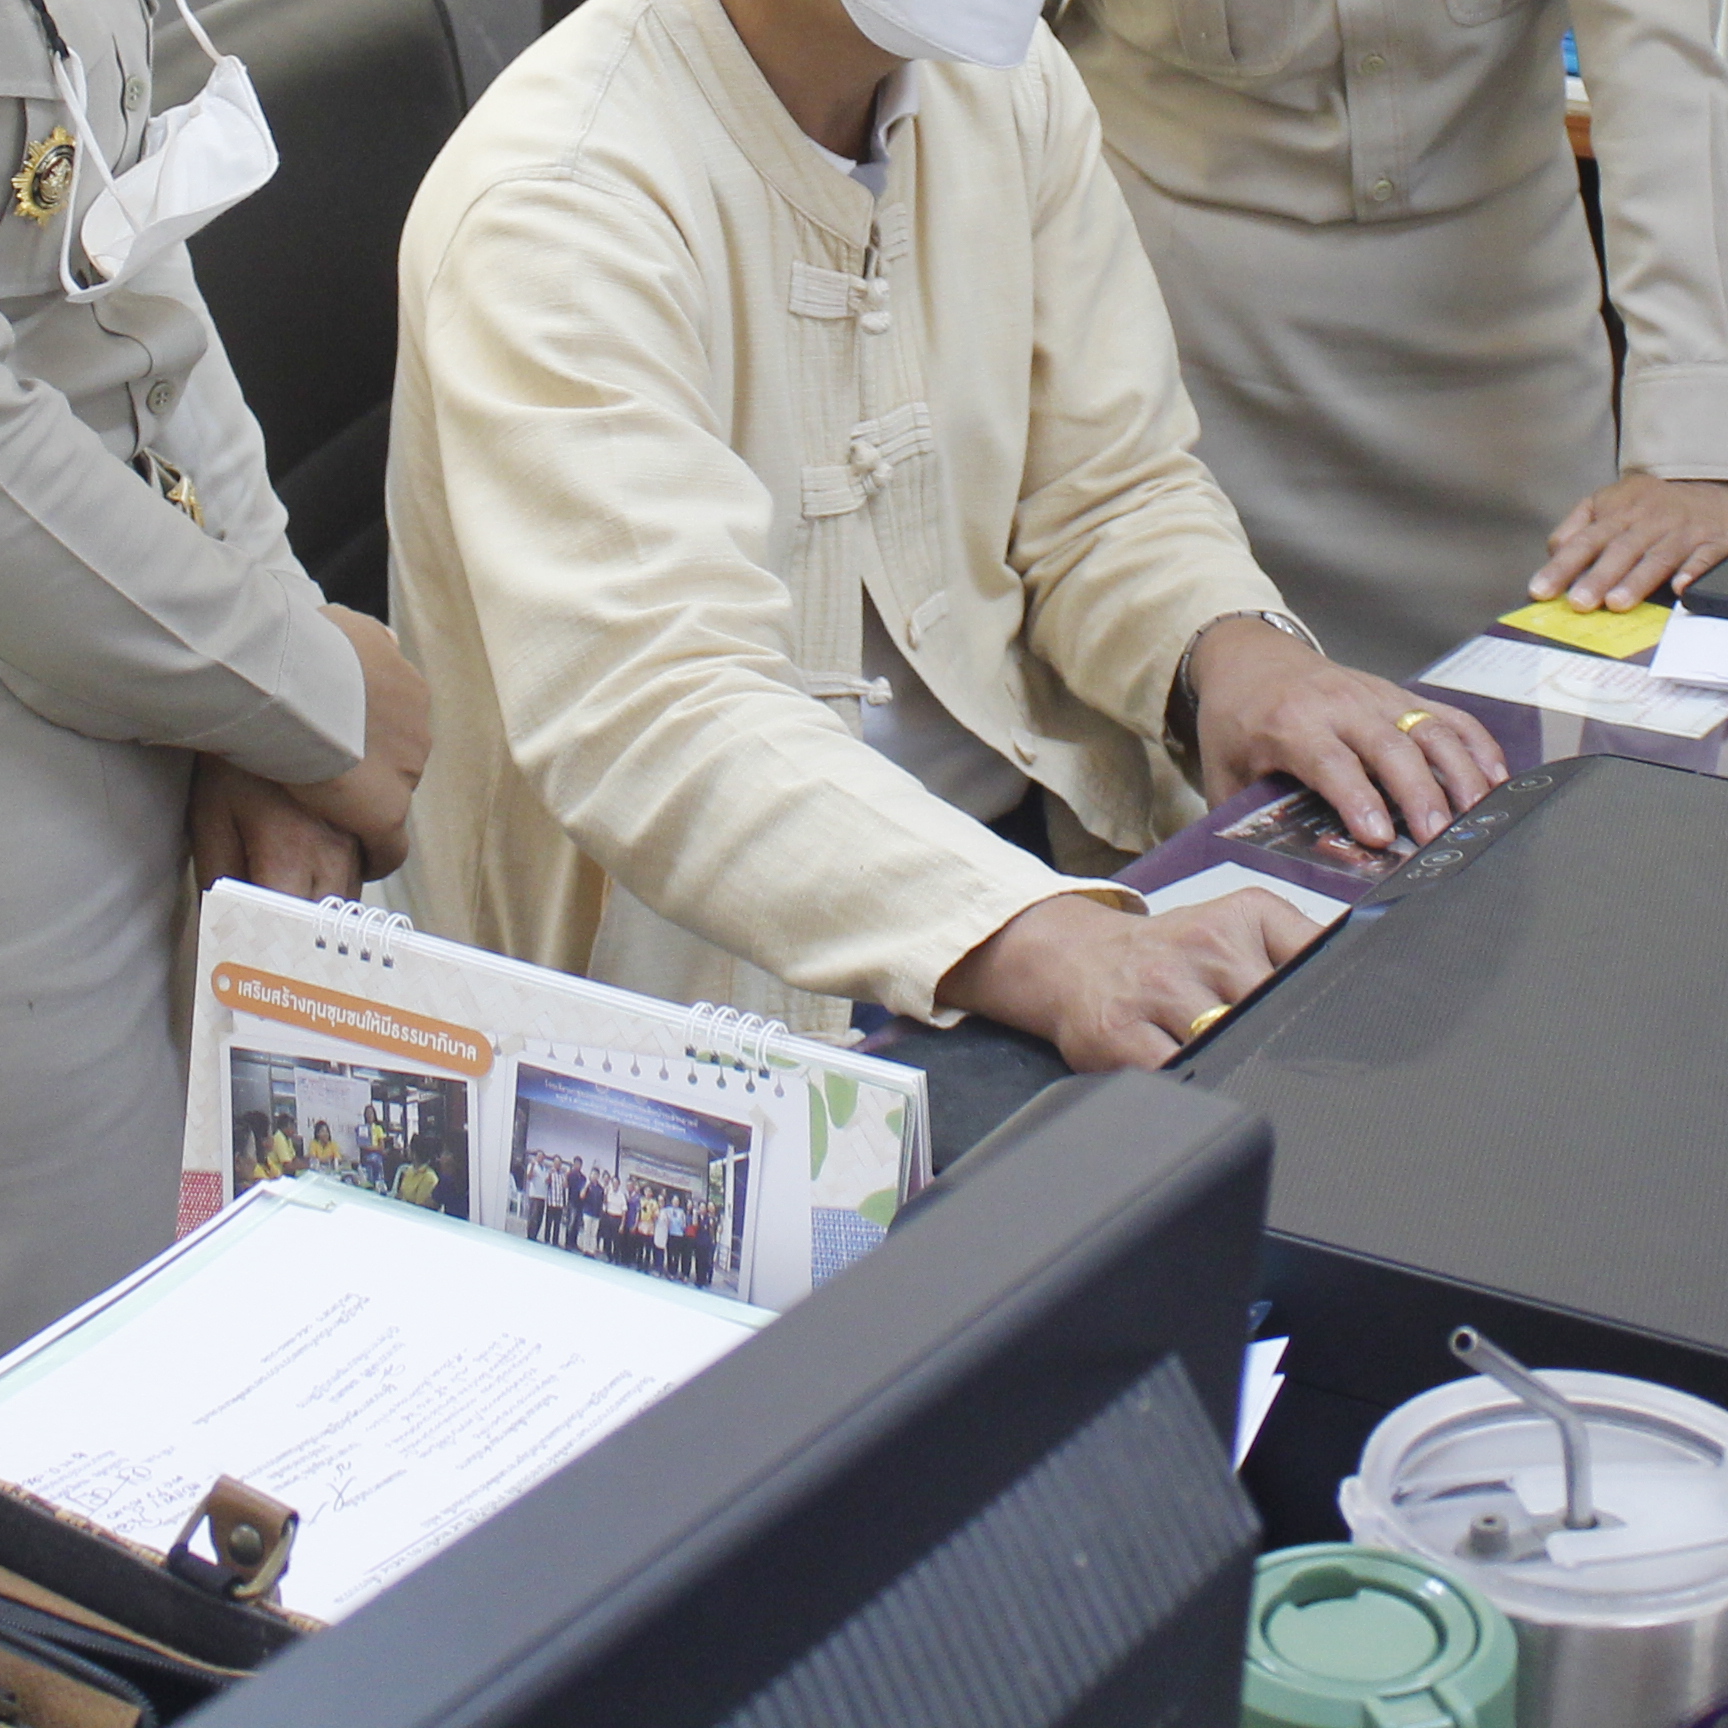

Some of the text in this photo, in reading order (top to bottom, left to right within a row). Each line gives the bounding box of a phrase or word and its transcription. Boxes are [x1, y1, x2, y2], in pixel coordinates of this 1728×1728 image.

[238, 978, 478, 1062] เสริมสร้างทุนชุมชนให้มีธรรมาภิบาล
